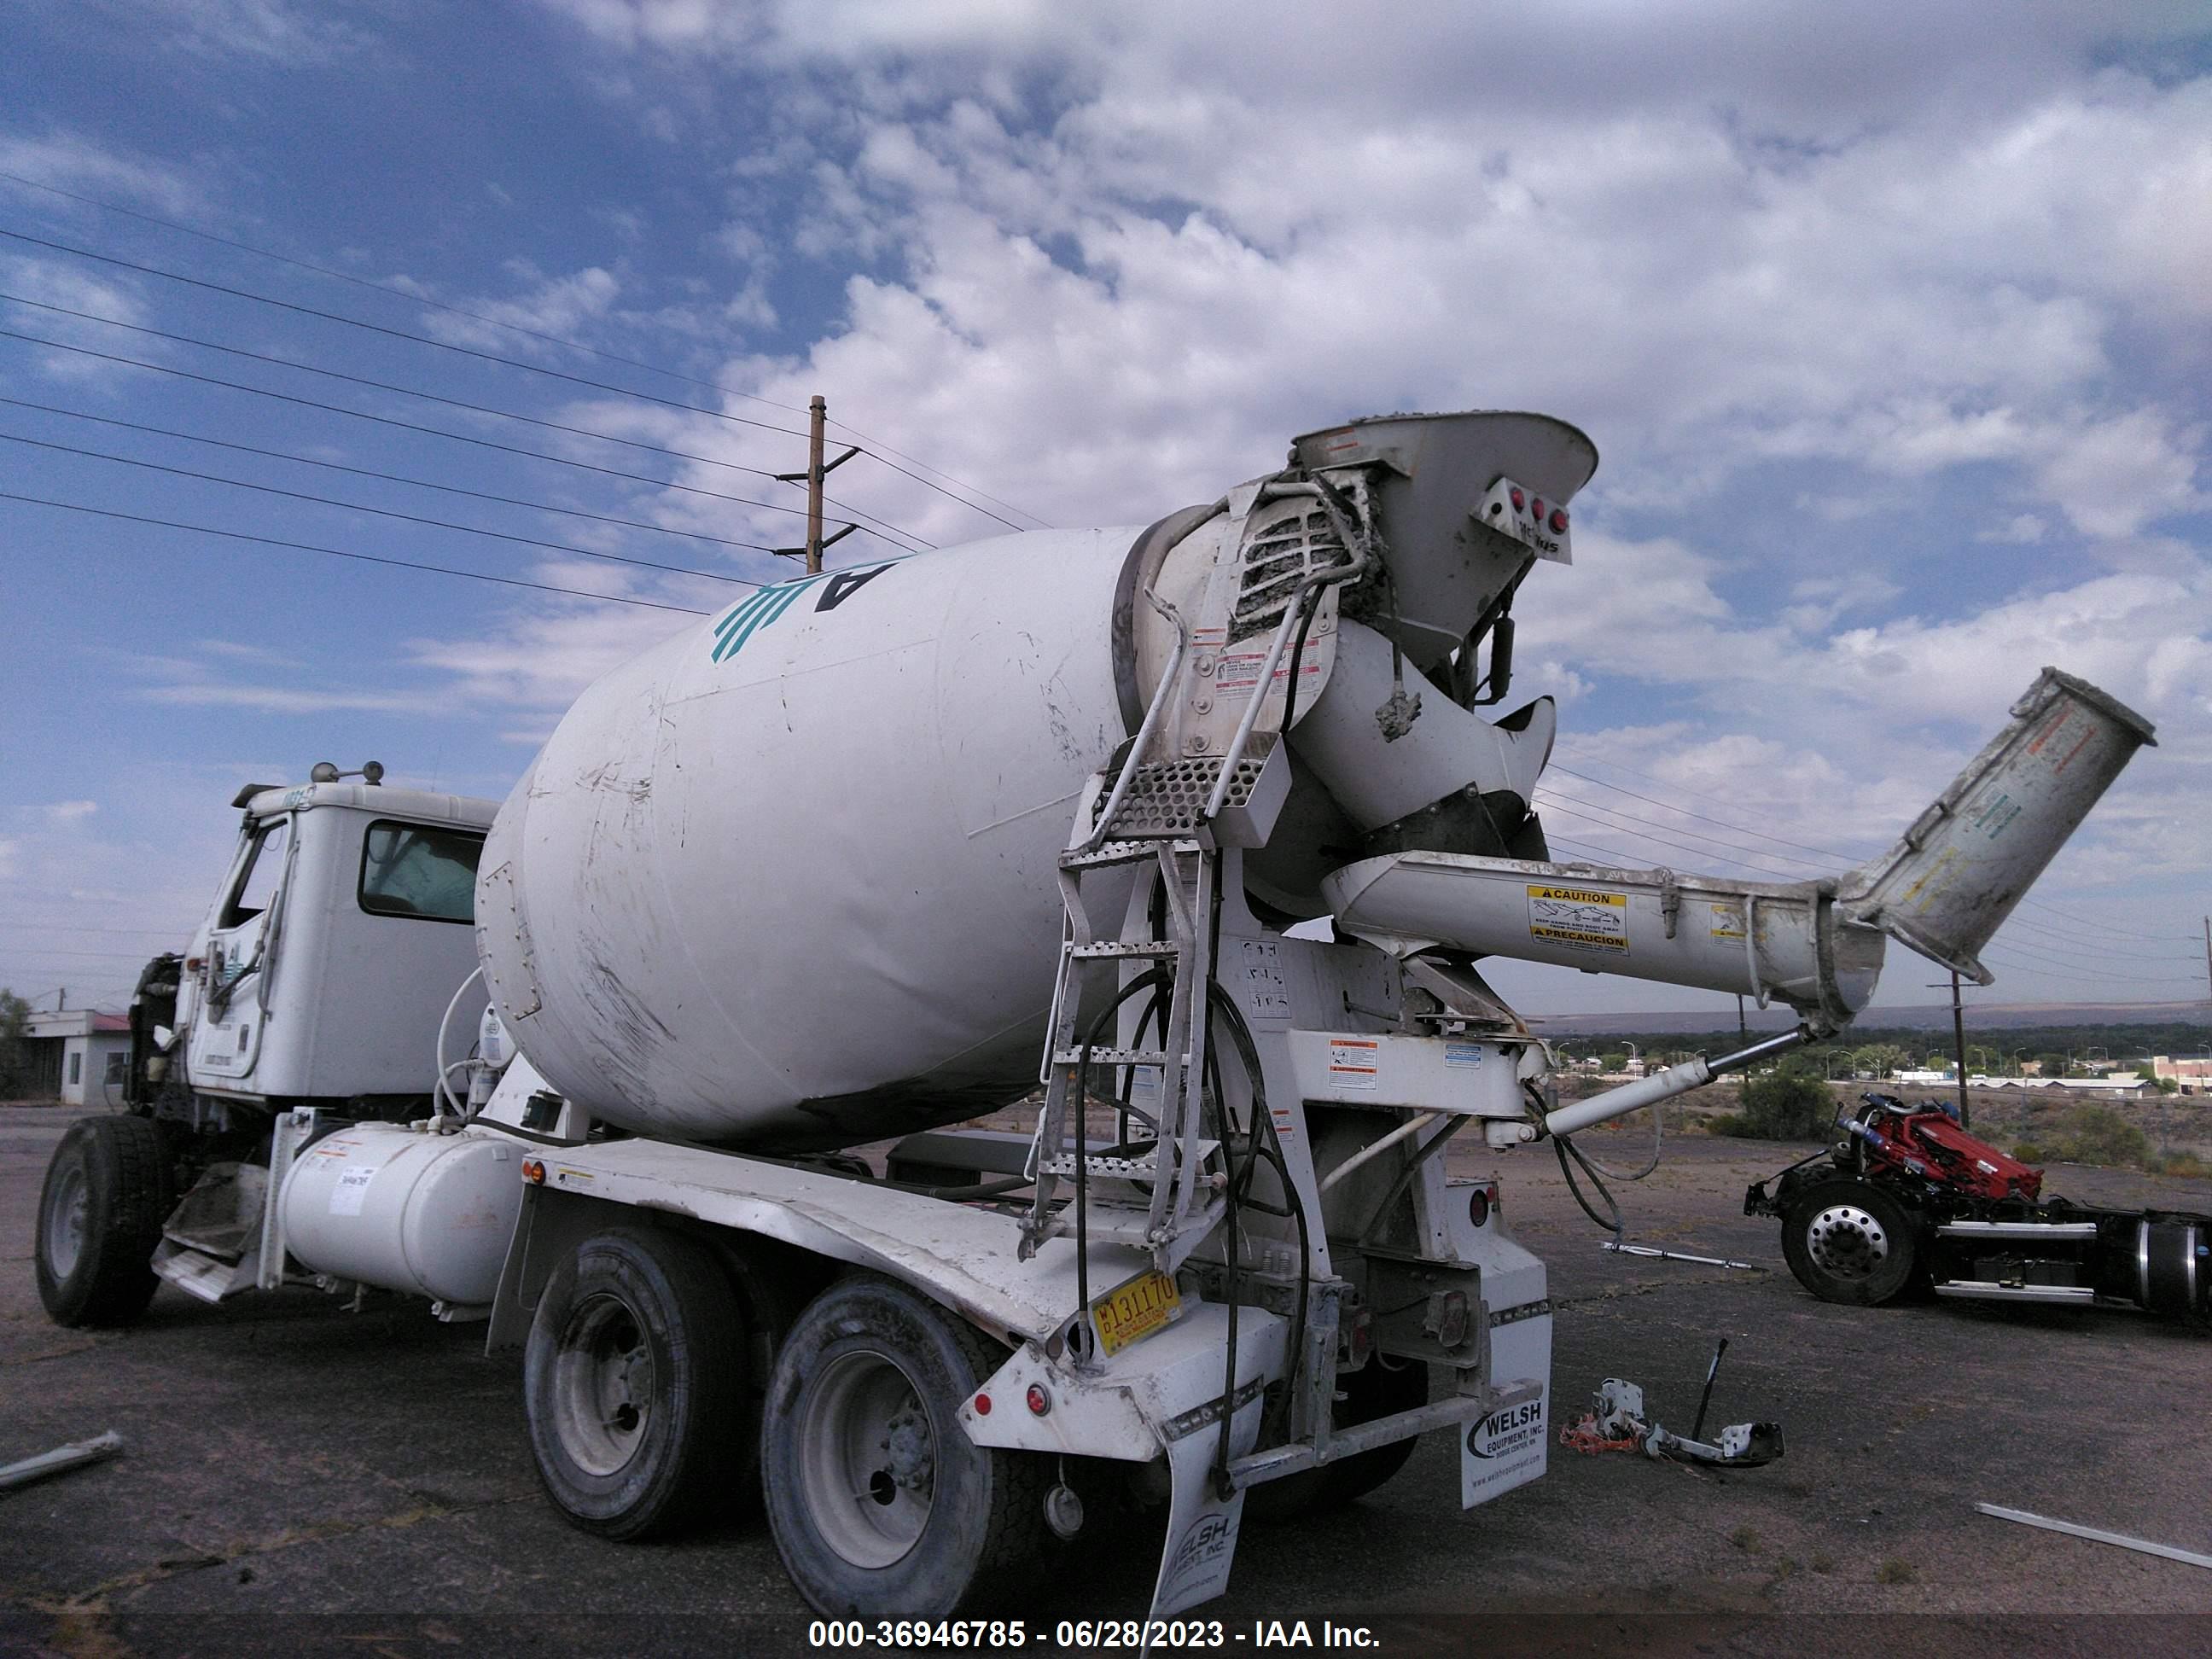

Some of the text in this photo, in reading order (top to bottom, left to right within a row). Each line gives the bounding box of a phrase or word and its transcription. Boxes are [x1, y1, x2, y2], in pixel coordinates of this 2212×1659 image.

[1554, 889, 1610, 905] CAUTION
[1545, 929, 1624, 946] PRECAUCION
[1109, 1275, 1173, 1329] 131170
[1487, 1402, 1541, 1437] WELSH
[1487, 1424, 1545, 1453] EQUIPMENT, INC.
